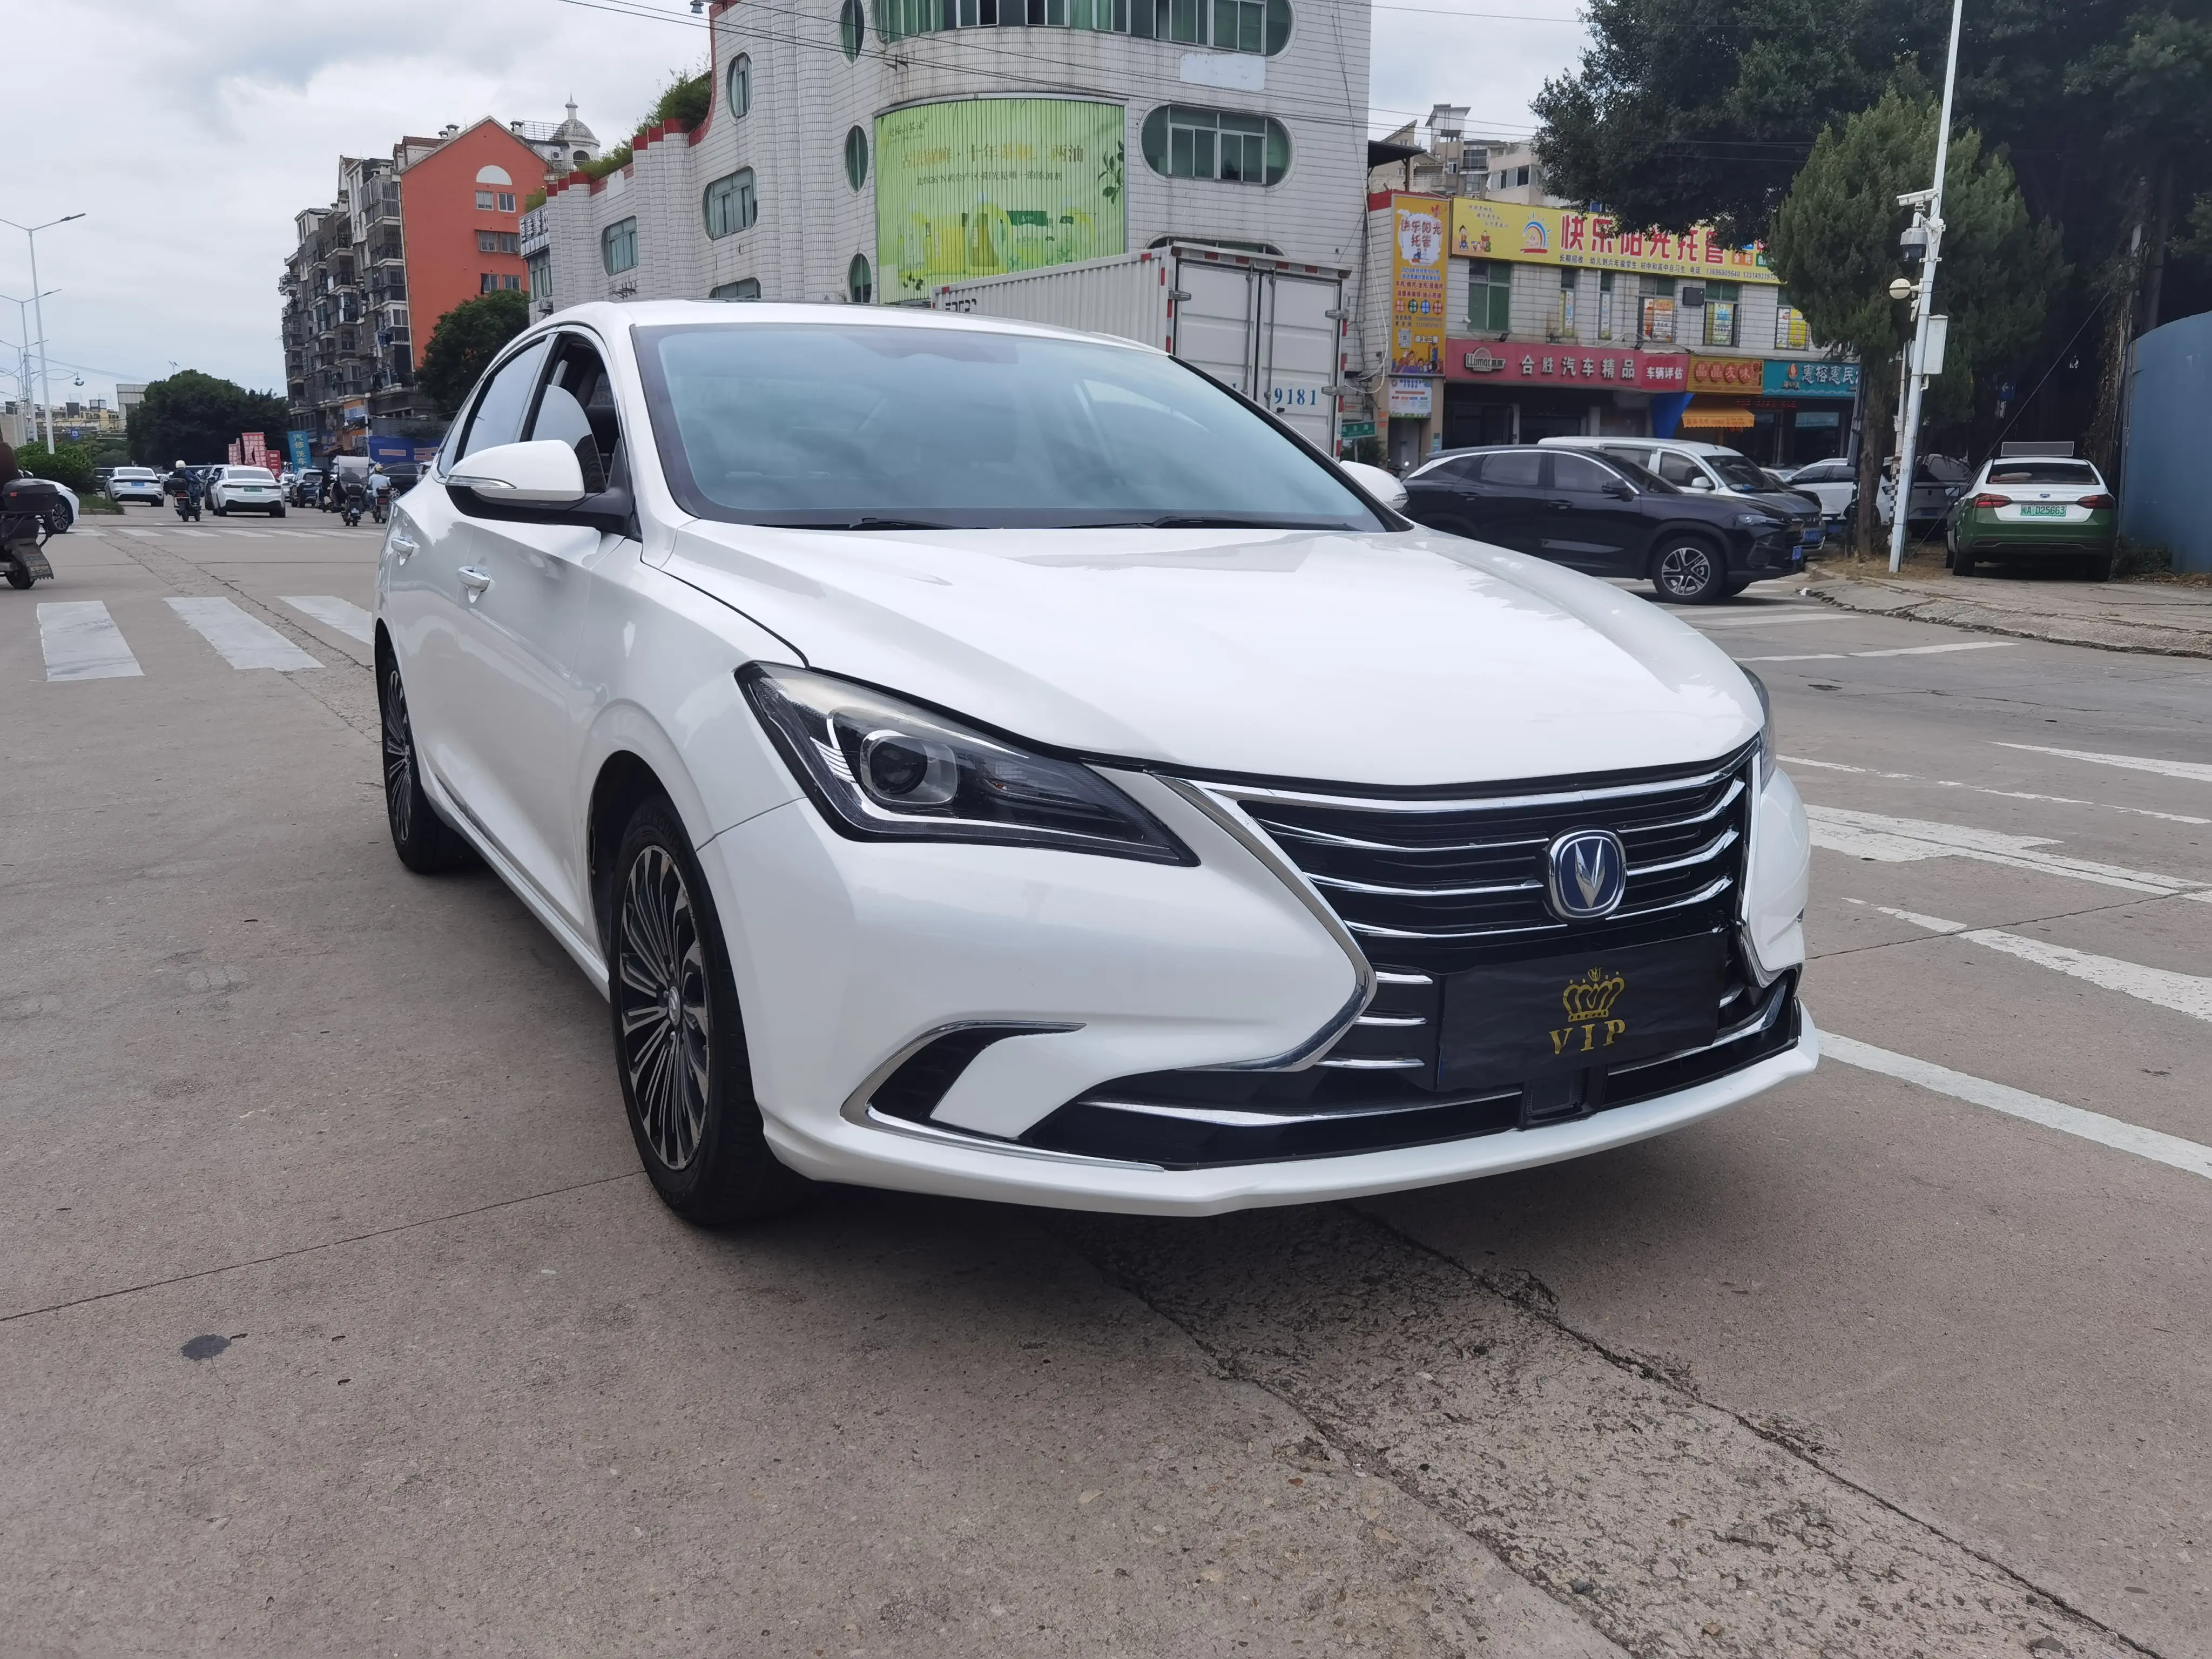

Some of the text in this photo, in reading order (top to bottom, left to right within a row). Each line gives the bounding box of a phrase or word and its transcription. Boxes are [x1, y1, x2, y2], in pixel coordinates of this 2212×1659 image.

[1401, 218, 1442, 235] 快乐阳光
[1411, 234, 1432, 248] 托管
[1560, 253, 1583, 264] 长期招收
[1590, 257, 1637, 269] 幼儿到六年级学生
[1641, 261, 1685, 274] 初中和高中自习生
[1707, 268, 1740, 278] 13696809640
[1521, 354, 1635, 379] 合胜汽车精品
[1646, 367, 1683, 380] 车辆评估
[1802, 364, 1859, 385] 惠榕惠民
[1274, 388, 1316, 406] 9181
[1548, 1019, 1626, 1055] VIP
